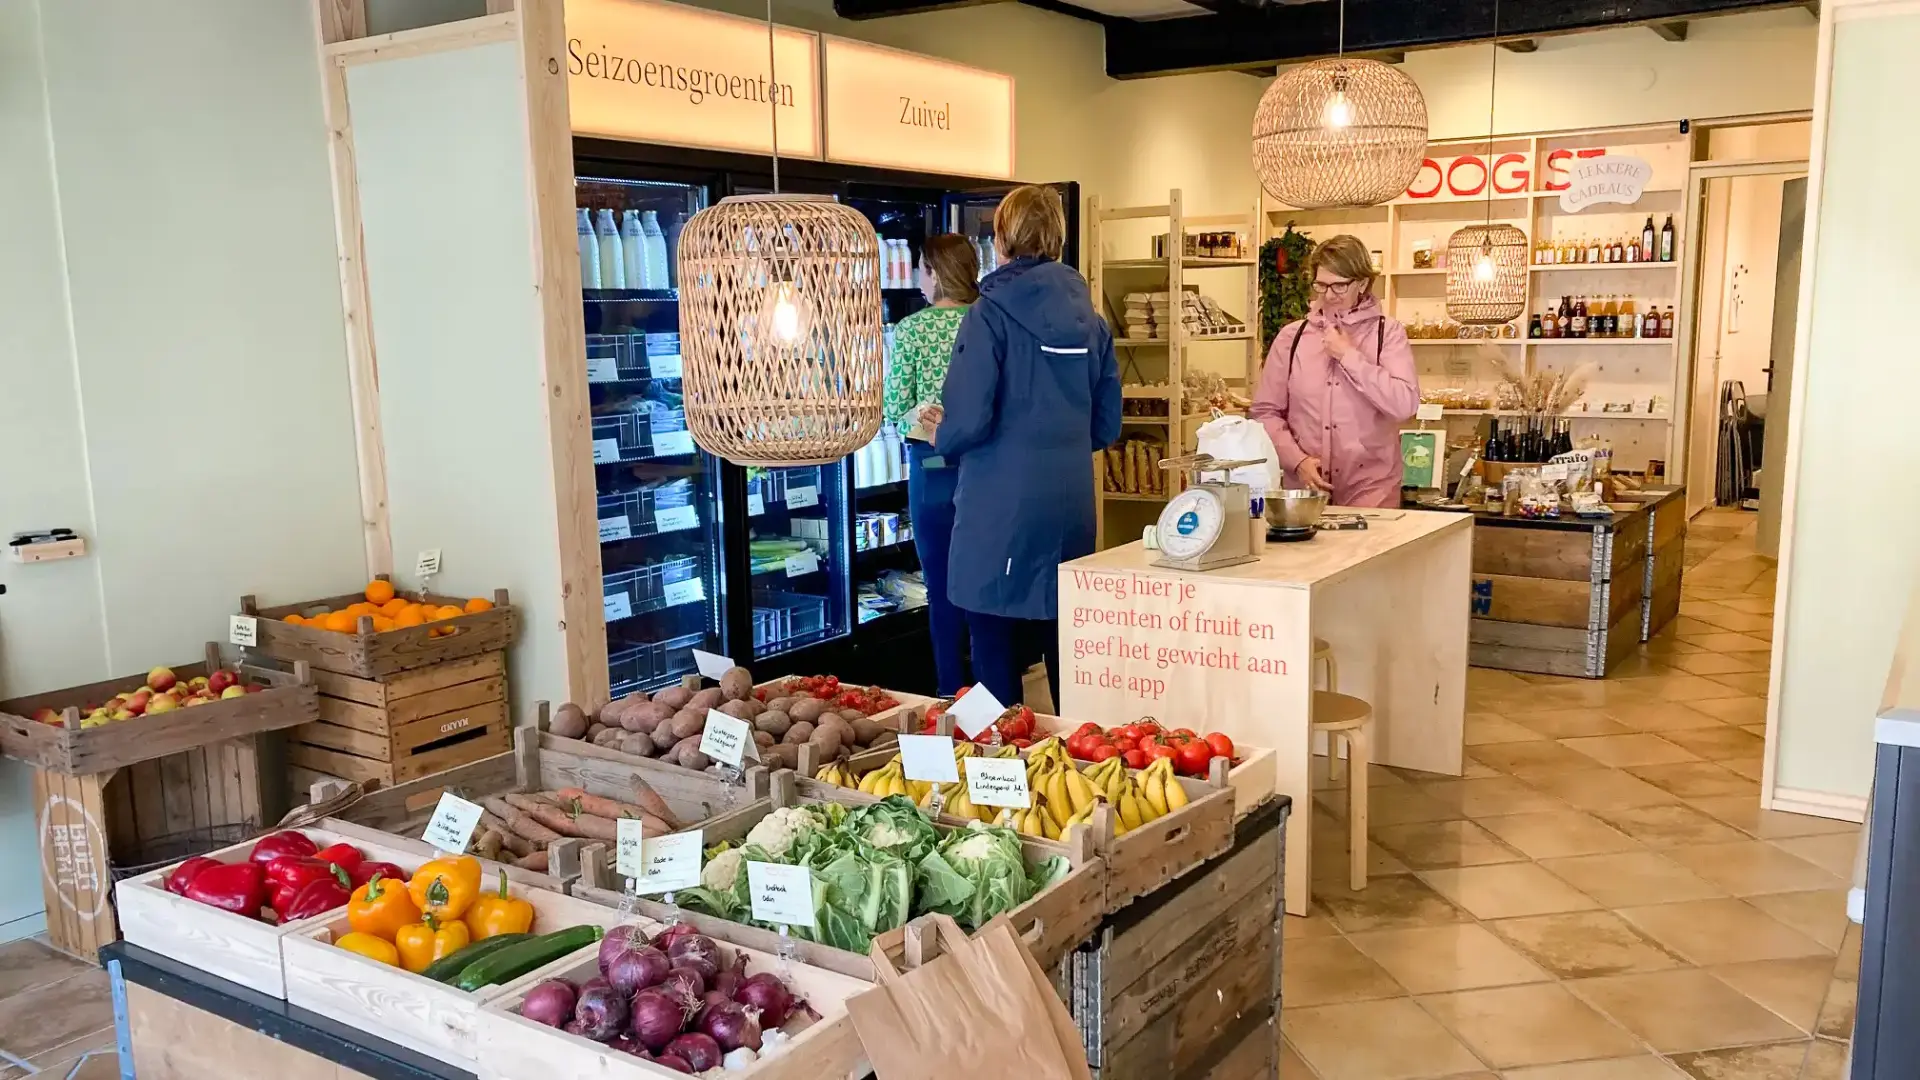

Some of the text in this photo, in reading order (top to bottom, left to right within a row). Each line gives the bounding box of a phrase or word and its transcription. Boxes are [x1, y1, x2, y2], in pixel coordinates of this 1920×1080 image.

[567, 38, 795, 108] Seizoensgroenten
[899, 96, 951, 131] Zuivel
[1578, 162, 1640, 179] LEKKERE
[1568, 182, 1635, 204] CADEAUS
[1073, 570, 1197, 605] Weeg hier je
[1073, 606, 1275, 640] groenten of fruit en
[1073, 635, 1288, 676] geef het gewicht aan
[1074, 665, 1166, 700] in de app
